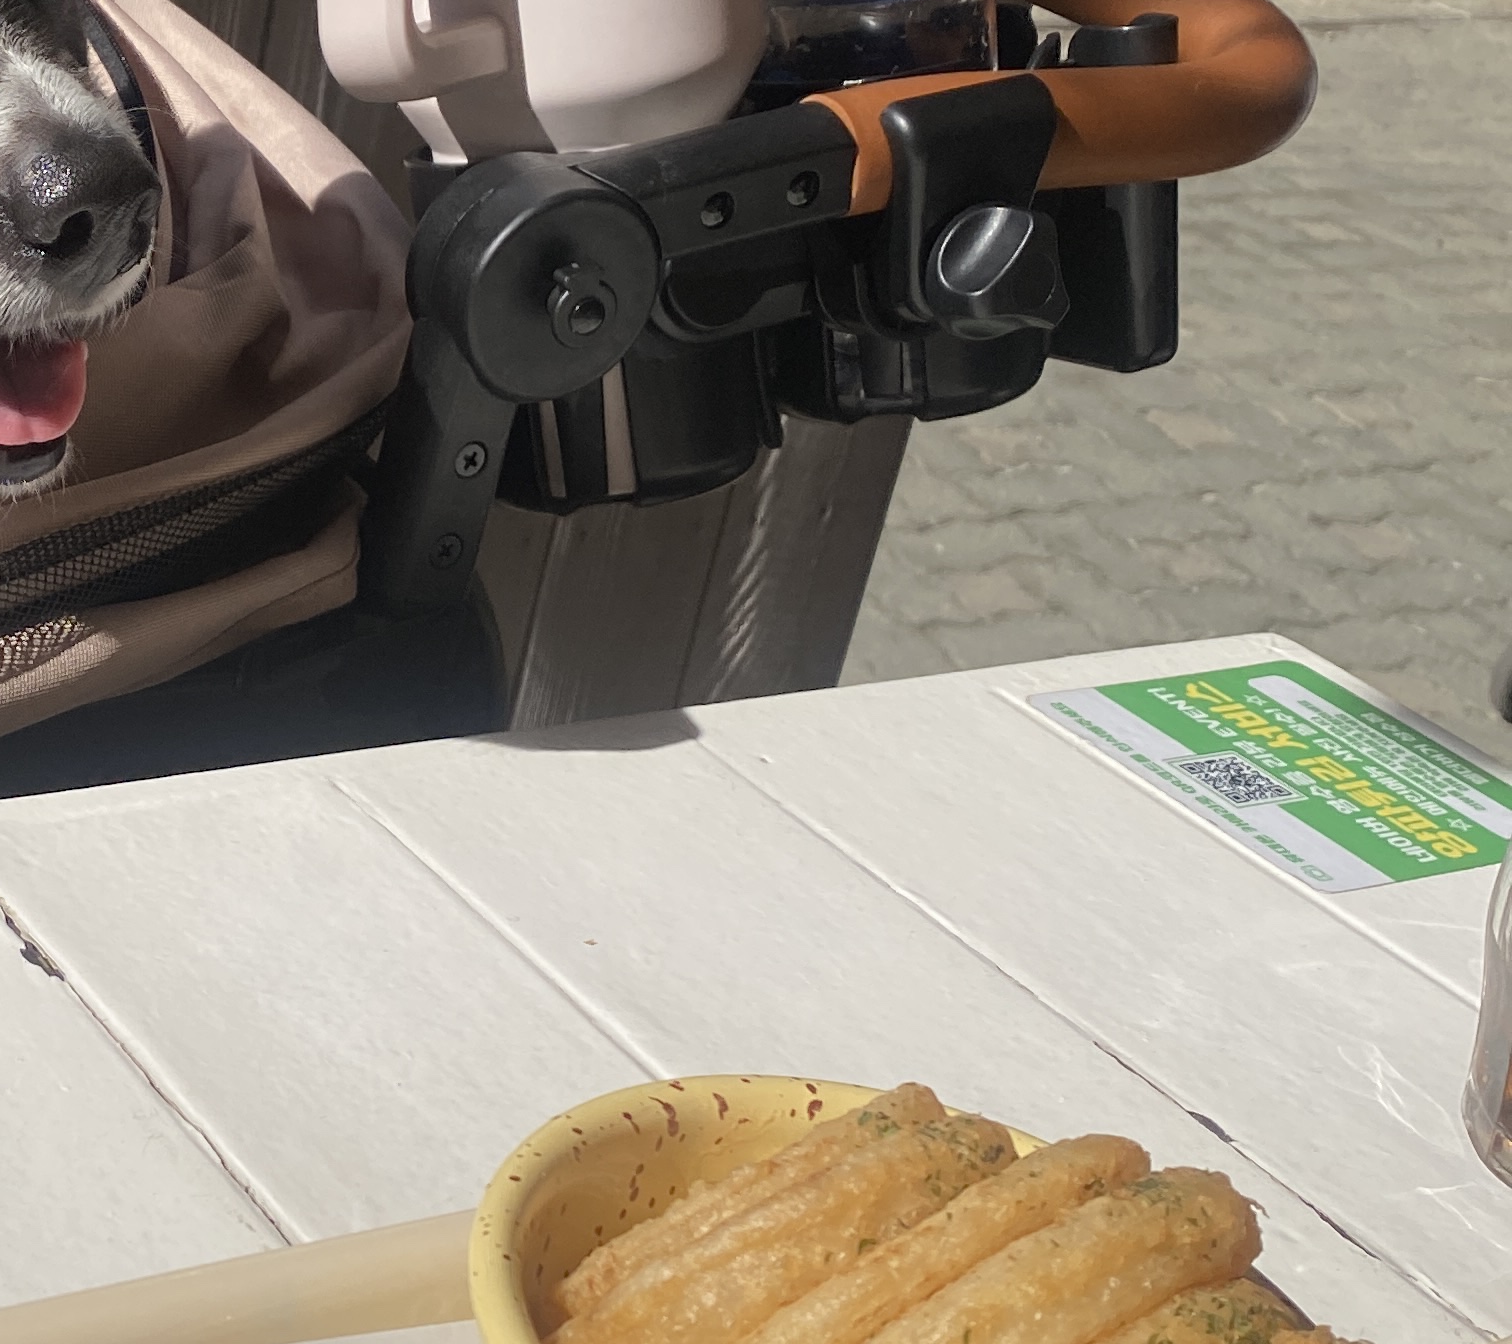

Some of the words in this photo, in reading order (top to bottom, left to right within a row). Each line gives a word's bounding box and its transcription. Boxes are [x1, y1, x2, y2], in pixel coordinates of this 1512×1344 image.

[1146, 686, 1240, 739] EVENT!
[1185, 681, 1308, 749] 서비스
[1231, 739, 1288, 769] 리뷰
[1312, 736, 1364, 763] 사진
[1280, 770, 1362, 816] 영수증
[1296, 755, 1478, 859] 양파튀김
[1361, 764, 1450, 817] 메인메뉴
[1354, 815, 1439, 864] 네이버
